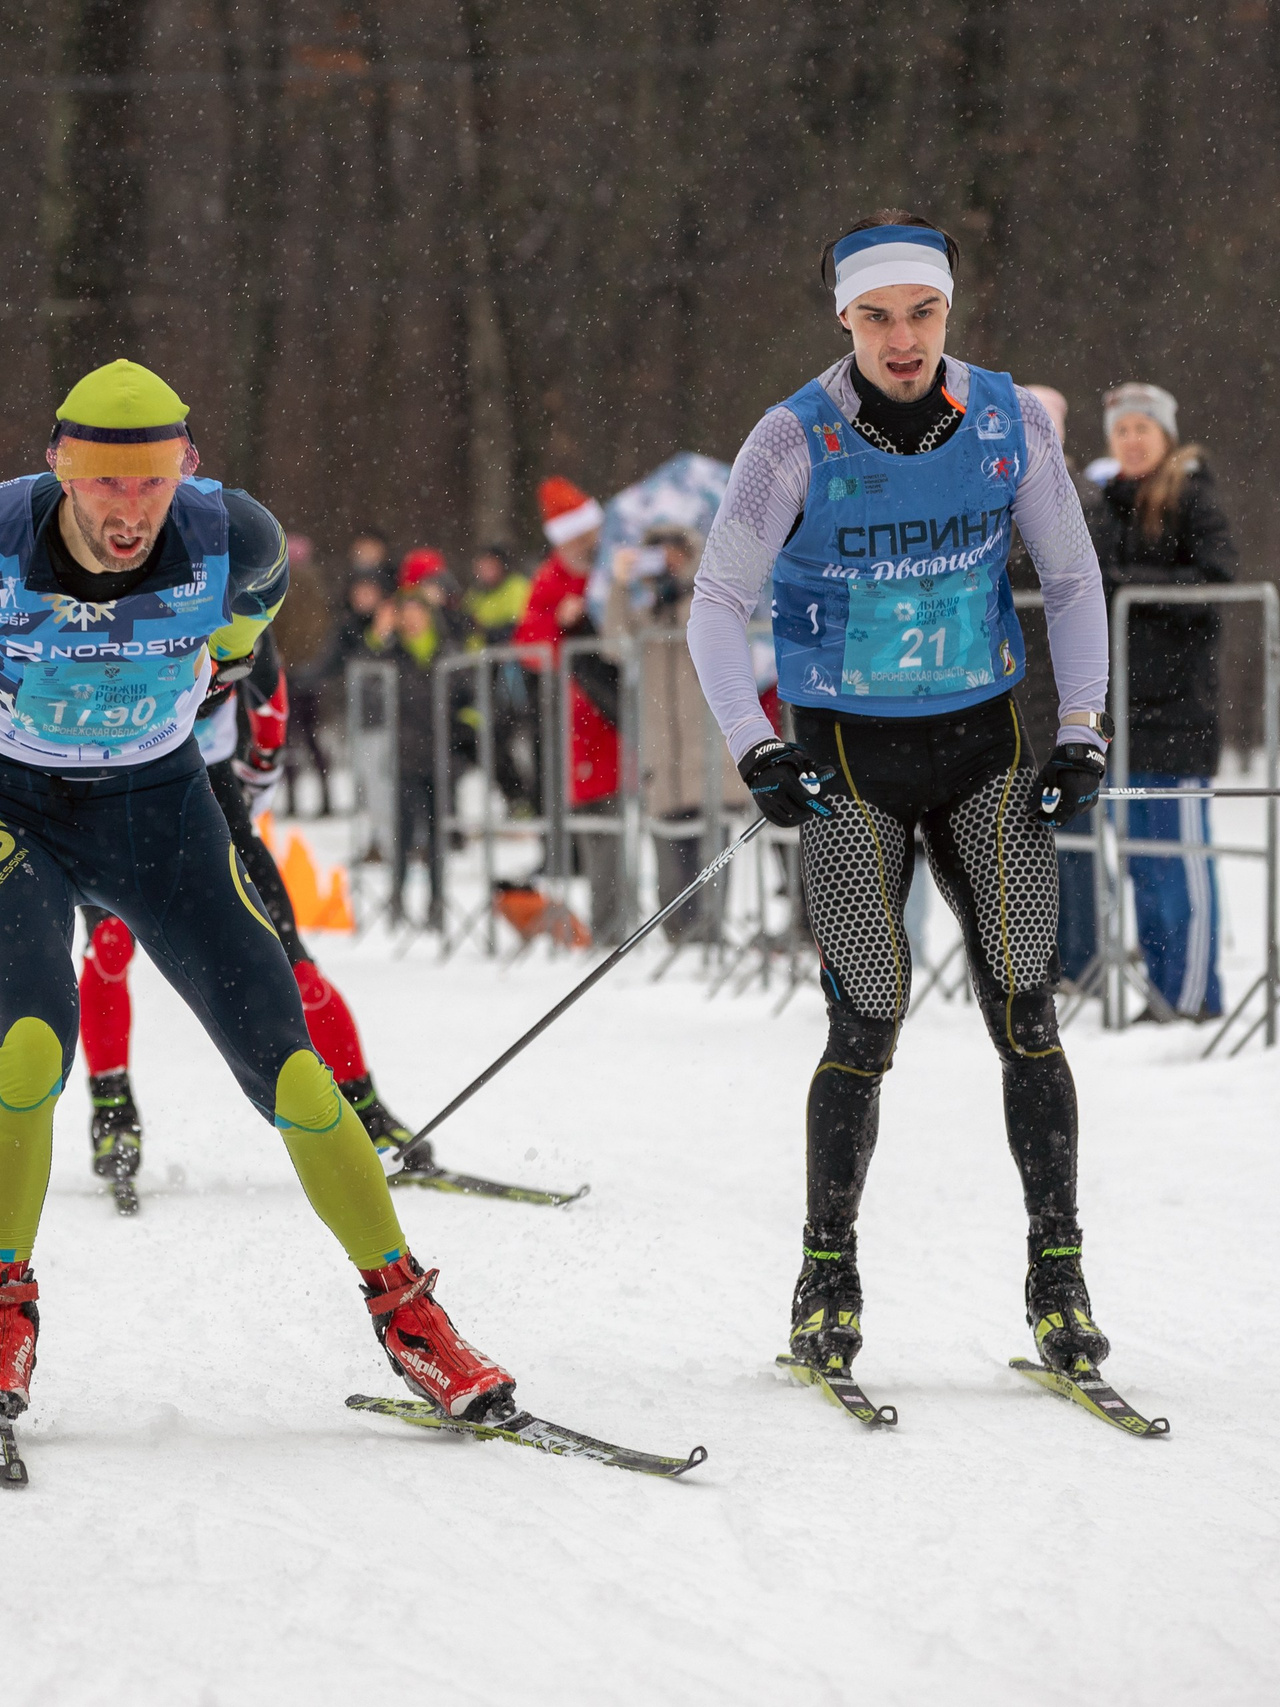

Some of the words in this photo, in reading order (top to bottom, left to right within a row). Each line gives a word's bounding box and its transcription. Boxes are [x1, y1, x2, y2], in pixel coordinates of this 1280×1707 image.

[838, 506, 1008, 558] СПРИНТ
[823, 563, 860, 580] на
[173, 581, 207, 598] CUP
[50, 637, 196, 660] NORDSKI
[899, 626, 946, 668] 21
[42, 723, 111, 737] ВОРОНЕЖСКАЯ
[1041, 1246, 1083, 1258] FISCH
[400, 1350, 451, 1390] alpina
